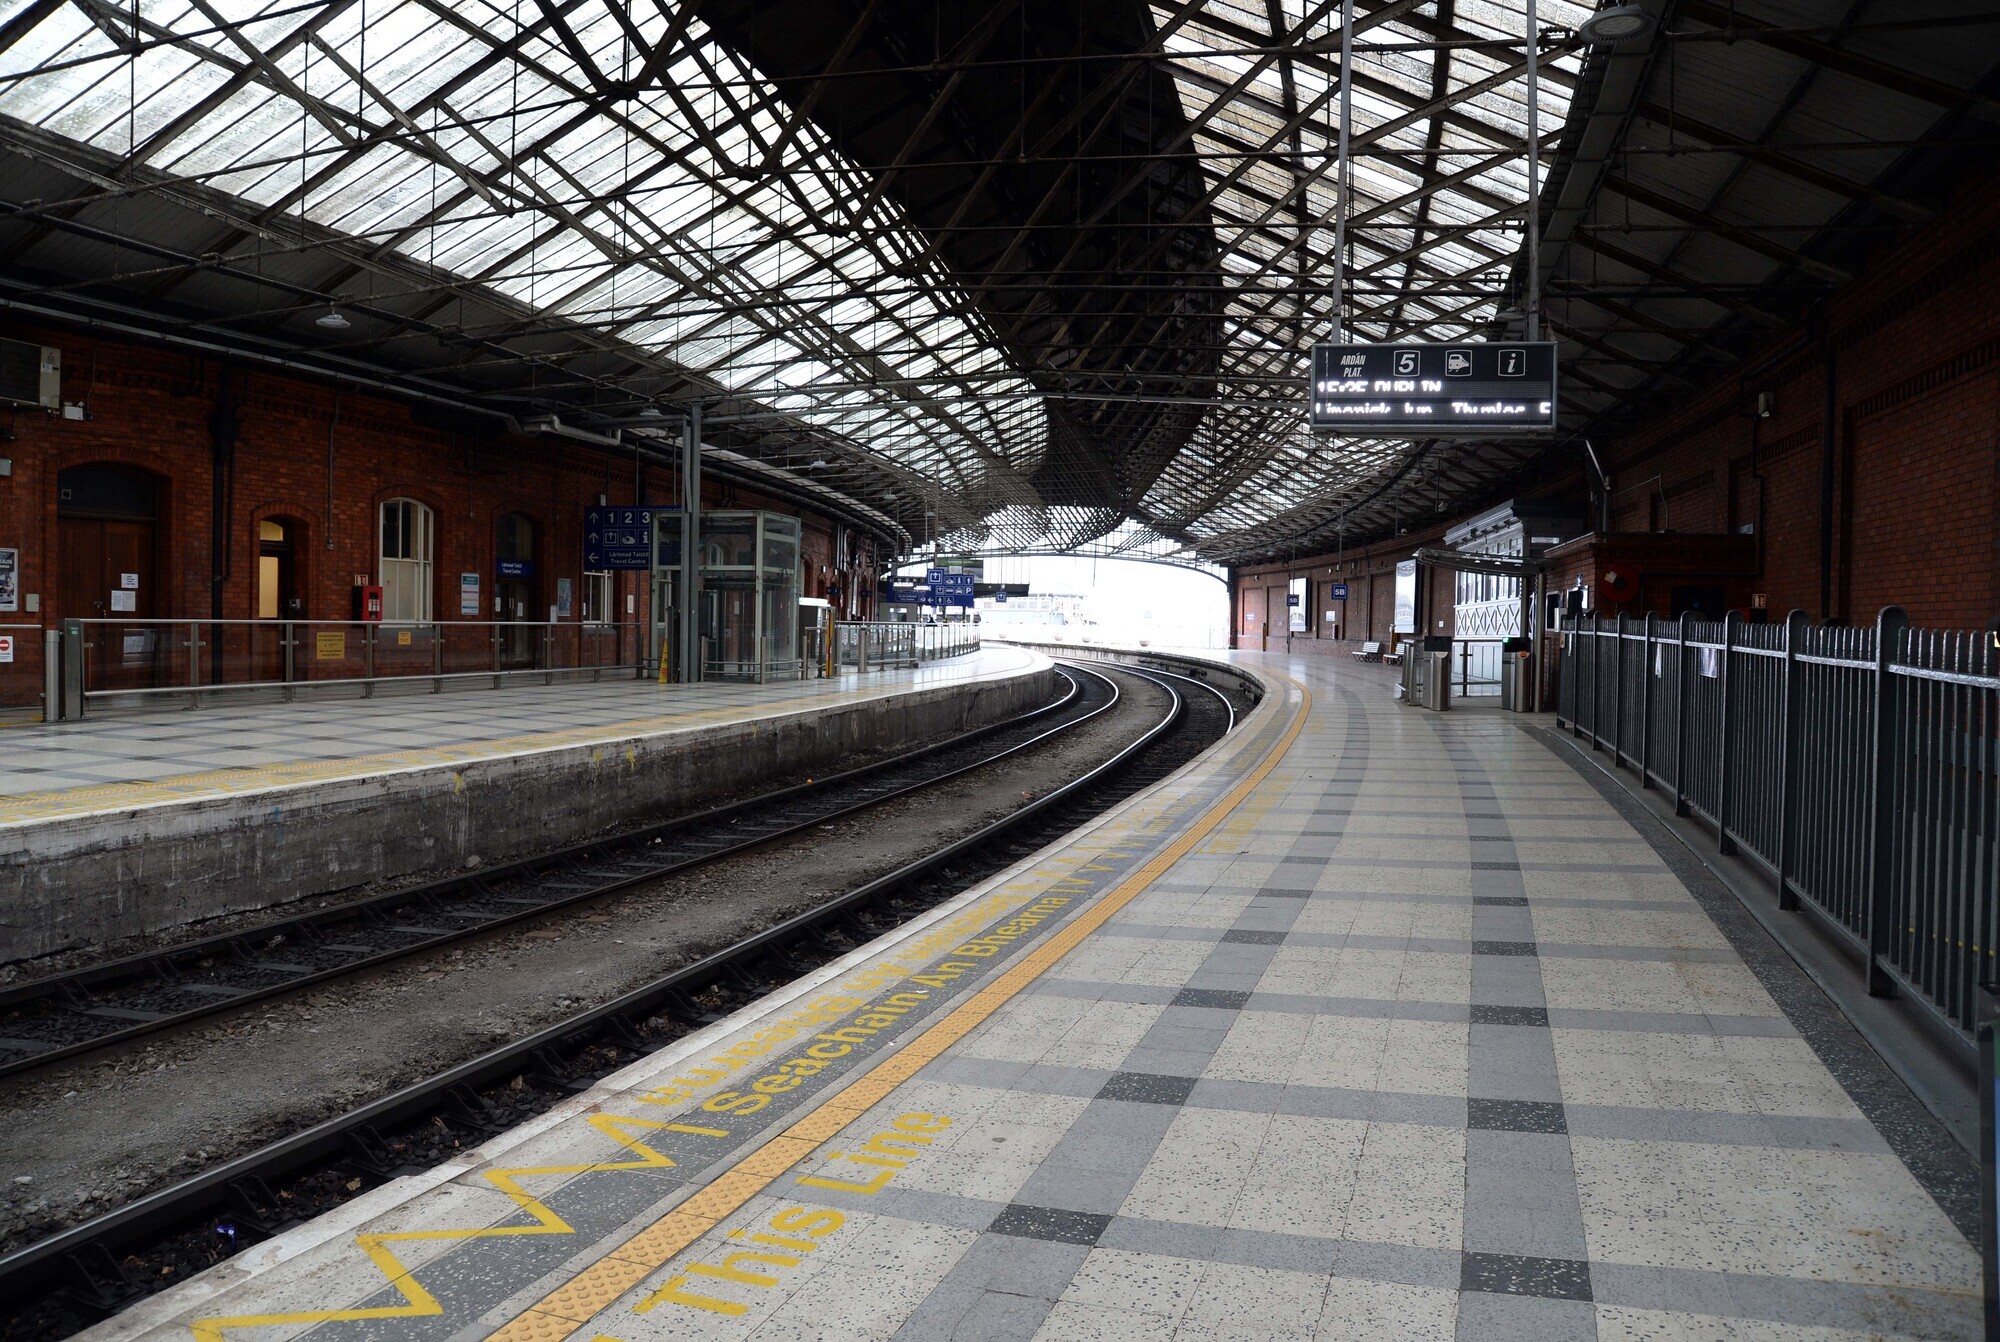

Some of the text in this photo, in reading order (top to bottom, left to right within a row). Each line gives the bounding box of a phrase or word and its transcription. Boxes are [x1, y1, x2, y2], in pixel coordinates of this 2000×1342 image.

[1340, 352, 1366, 366] ARDÁN
[1398, 353, 1416, 373] 5
[1343, 367, 1362, 378] PLAT.
[608, 512, 650, 524] 1 2 3
[702, 896, 1072, 1115] Seachain An Bhearna
[631, 1112, 953, 1316] This Line
